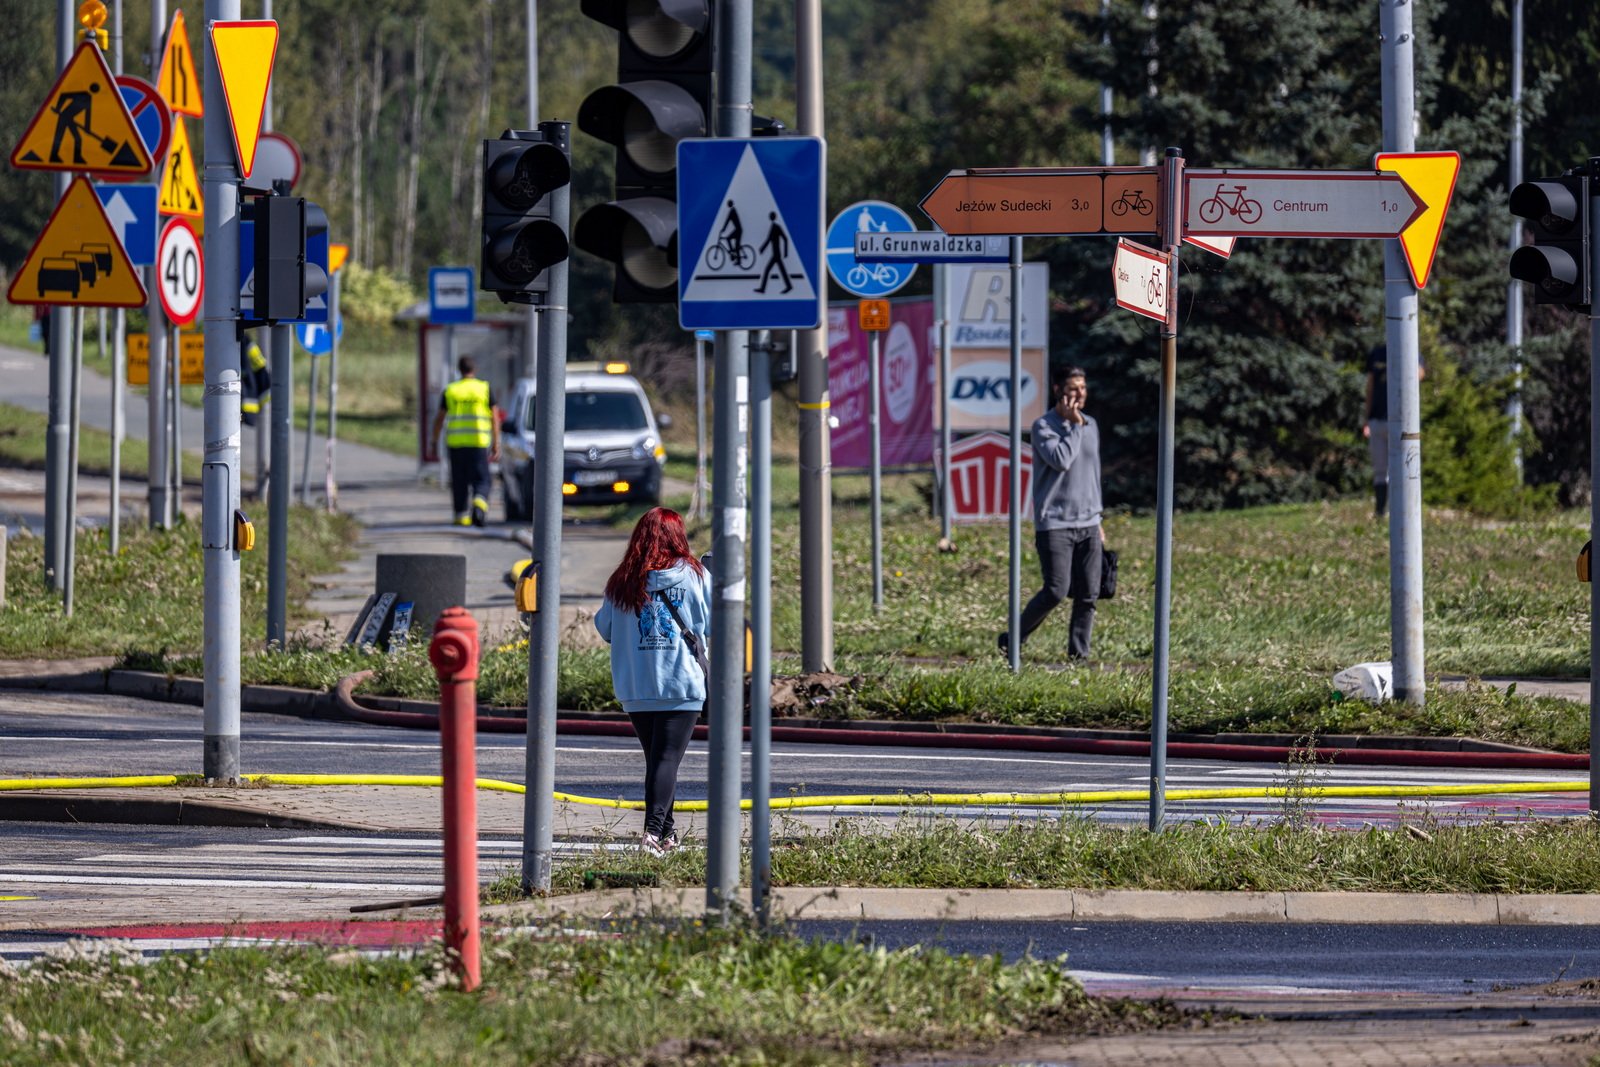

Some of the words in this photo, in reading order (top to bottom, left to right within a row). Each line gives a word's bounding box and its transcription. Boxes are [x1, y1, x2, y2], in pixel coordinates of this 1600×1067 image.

[955, 200, 996, 212] Jeżów
[1000, 200, 1052, 212] Sudecki
[1071, 199, 1089, 212] 3,0
[1273, 199, 1328, 212] Centrum
[1381, 200, 1398, 213] 1,0
[860, 237, 879, 252] ul.
[883, 237, 982, 252] Grunwaldzka
[165, 244, 198, 297] 40
[955, 325, 1027, 343] Route
